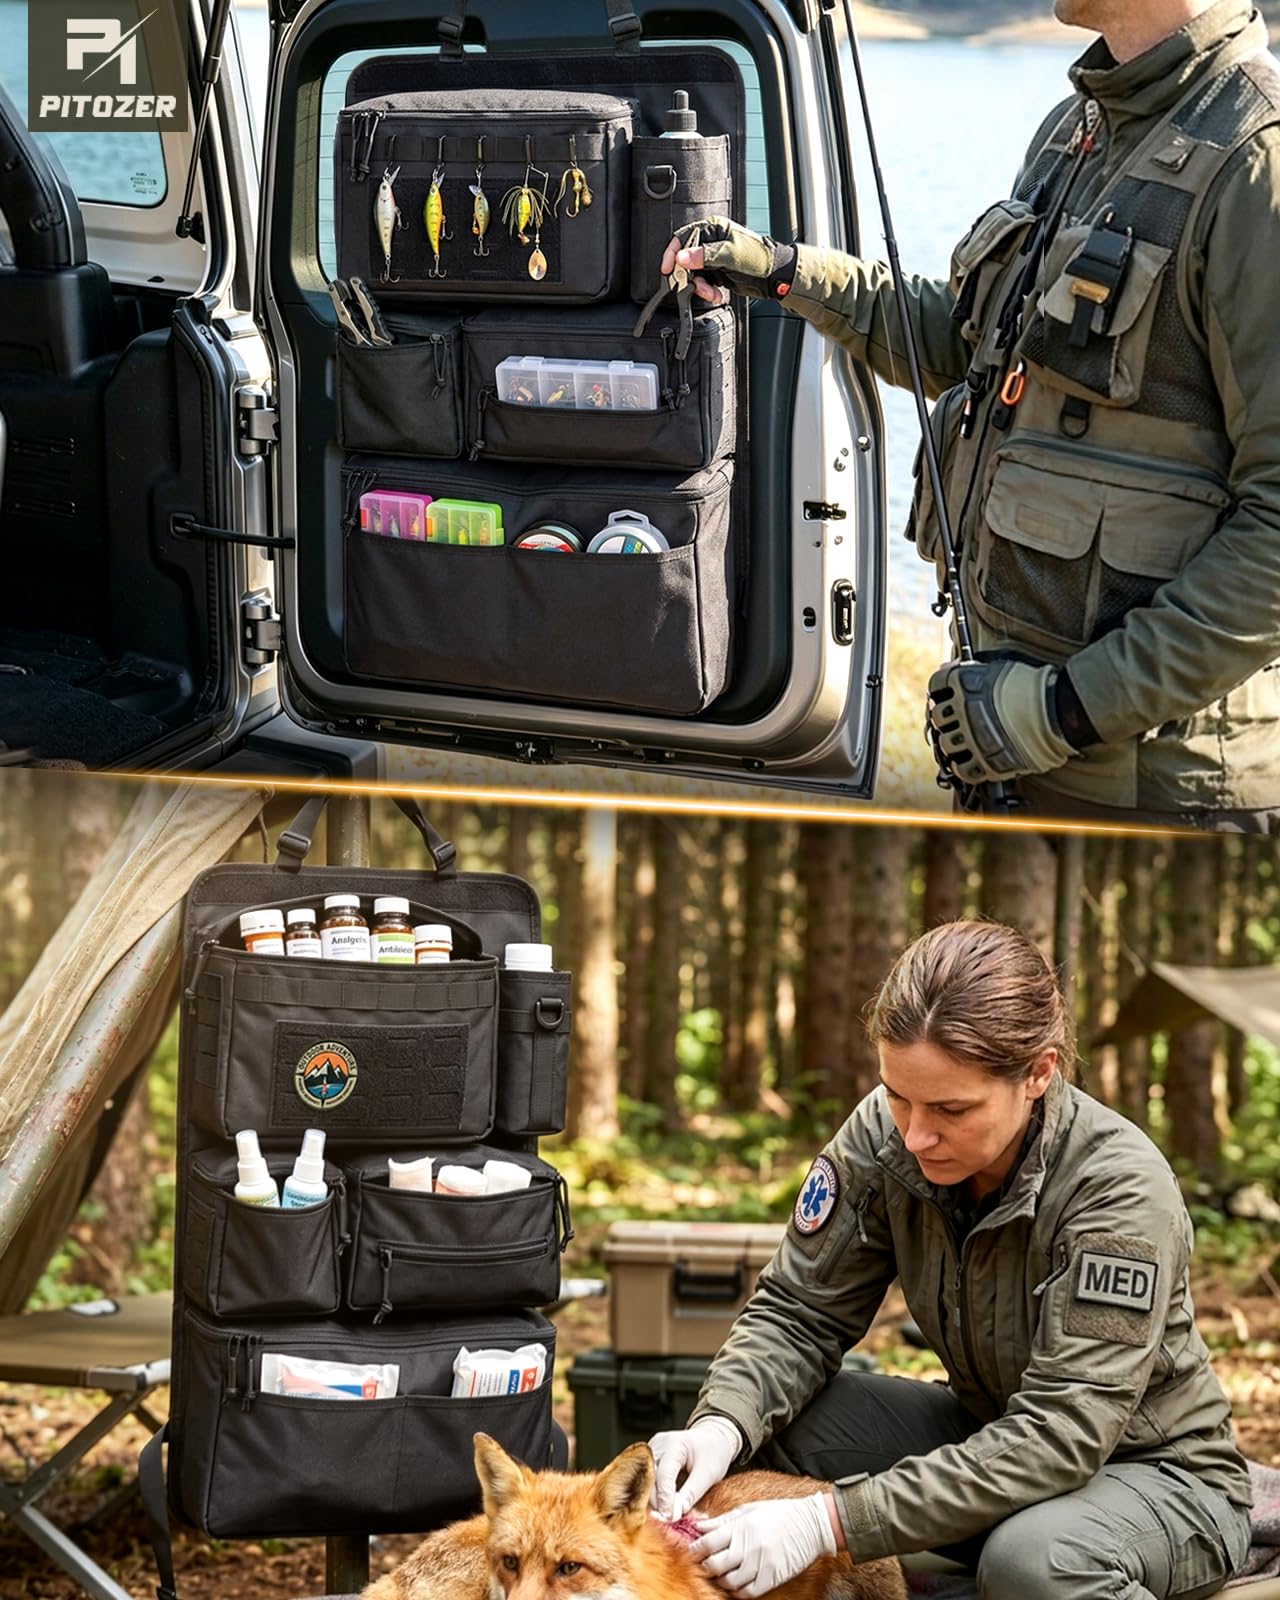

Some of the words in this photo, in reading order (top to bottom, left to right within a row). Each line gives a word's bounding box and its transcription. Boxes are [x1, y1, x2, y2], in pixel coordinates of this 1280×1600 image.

[298, 1044, 325, 1070] OUTDOOR
[326, 1044, 356, 1070] ADVENTURE
[1084, 1262, 1149, 1298] MED
